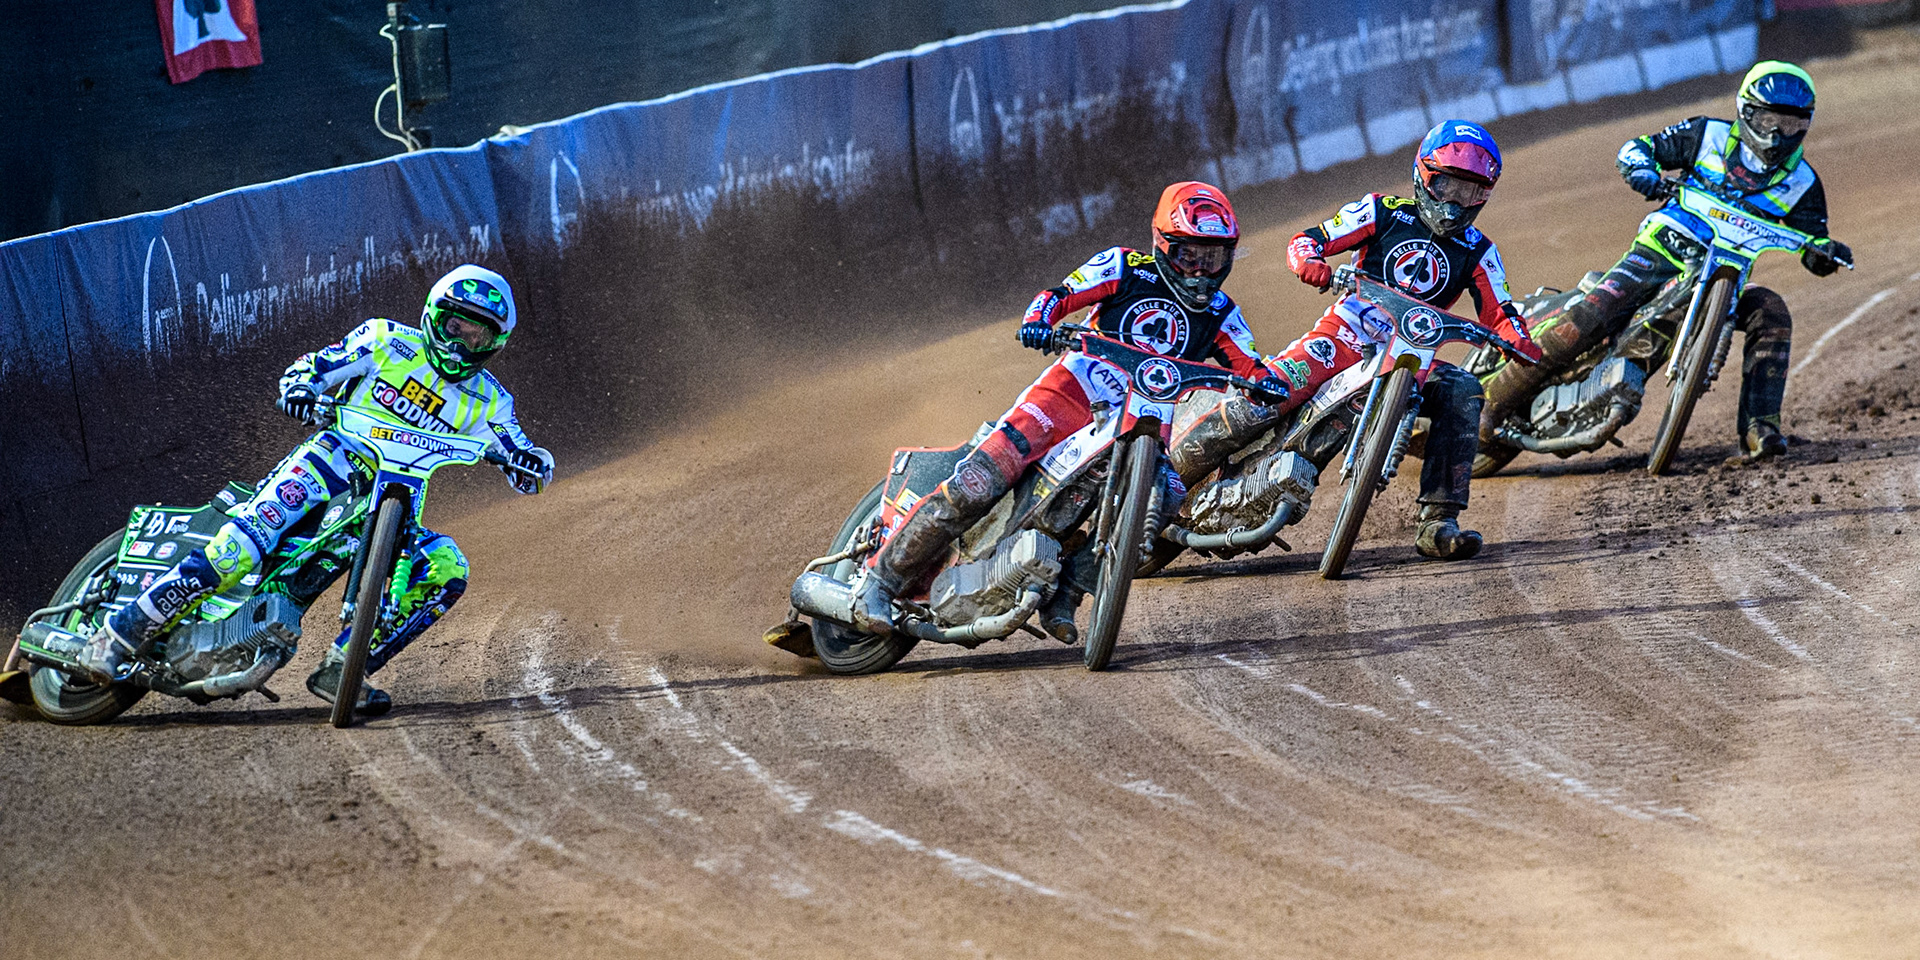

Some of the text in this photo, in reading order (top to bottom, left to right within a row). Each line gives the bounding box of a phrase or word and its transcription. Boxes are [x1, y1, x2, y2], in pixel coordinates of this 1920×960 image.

[1392, 243, 1418, 258] BELLE
[1422, 243, 1438, 256] VUE
[1437, 257, 1447, 278] ACES
[1132, 268, 1158, 281] ROWE
[1133, 302, 1186, 341] BELLE VUE ACES
[391, 339, 415, 358] ROWE
[1141, 361, 1156, 371] BELLE
[401, 380, 443, 414] BET
[371, 427, 453, 457] BETGOODWIN
[301, 469, 325, 494] FTS
[963, 470, 988, 493] STS
[261, 504, 281, 525] STS
